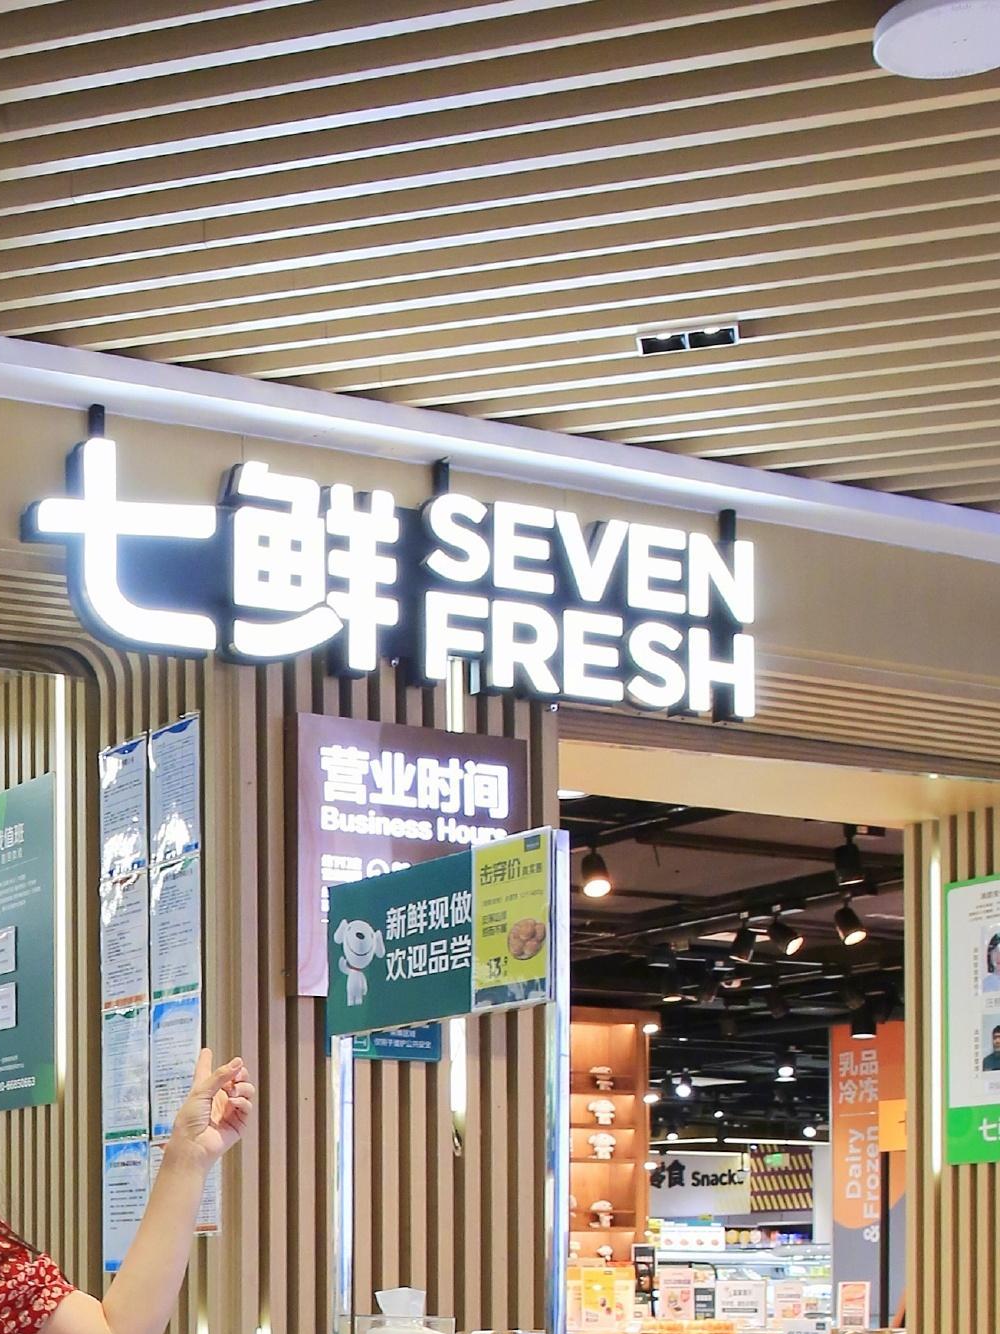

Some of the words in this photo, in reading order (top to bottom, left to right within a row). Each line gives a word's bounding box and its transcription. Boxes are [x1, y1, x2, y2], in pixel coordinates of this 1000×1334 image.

[38, 437, 399, 671] 七鲜
[427, 493, 755, 624] SEVEN
[424, 590, 755, 718] FRESH
[320, 744, 509, 819] 营业时间
[320, 805, 433, 841] Business
[480, 857, 521, 886] 击穿价
[386, 890, 472, 940] 新鲜现做
[386, 934, 472, 981] 欢迎品尝
[838, 1079, 879, 1104] 冷冻
[839, 1049, 879, 1076] 乳品
[845, 1128, 864, 1199] Dairy
[863, 1125, 879, 1219] Frozen
